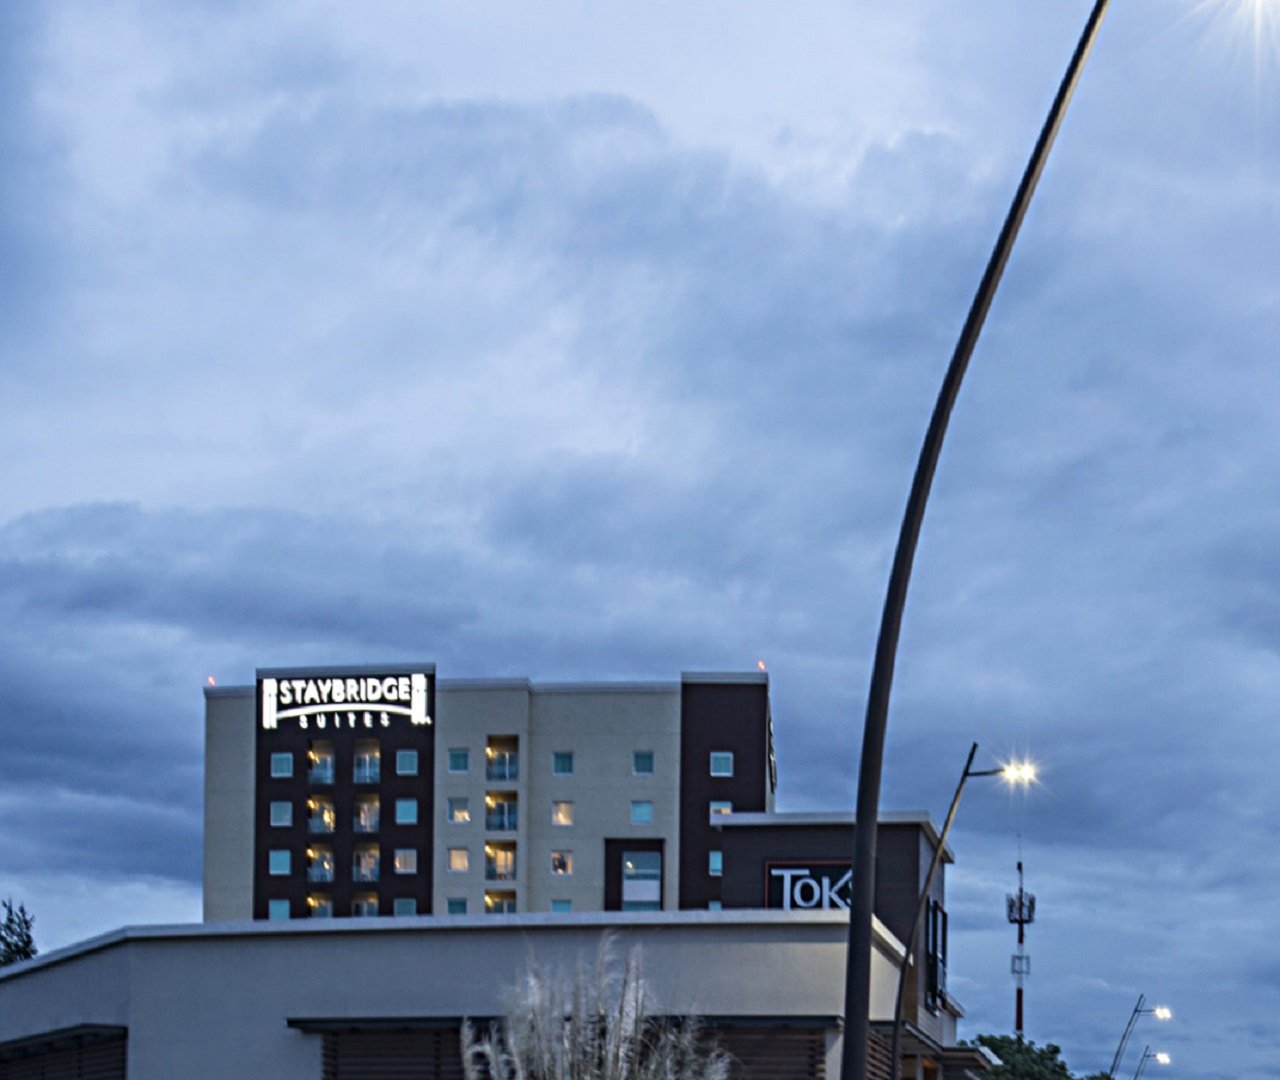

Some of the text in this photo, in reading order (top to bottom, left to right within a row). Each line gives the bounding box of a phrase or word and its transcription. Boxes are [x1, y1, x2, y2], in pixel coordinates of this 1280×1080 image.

[279, 677, 411, 705] STAYBRIDGE
[299, 712, 390, 729] SUITES
[770, 868, 852, 910] TOK
